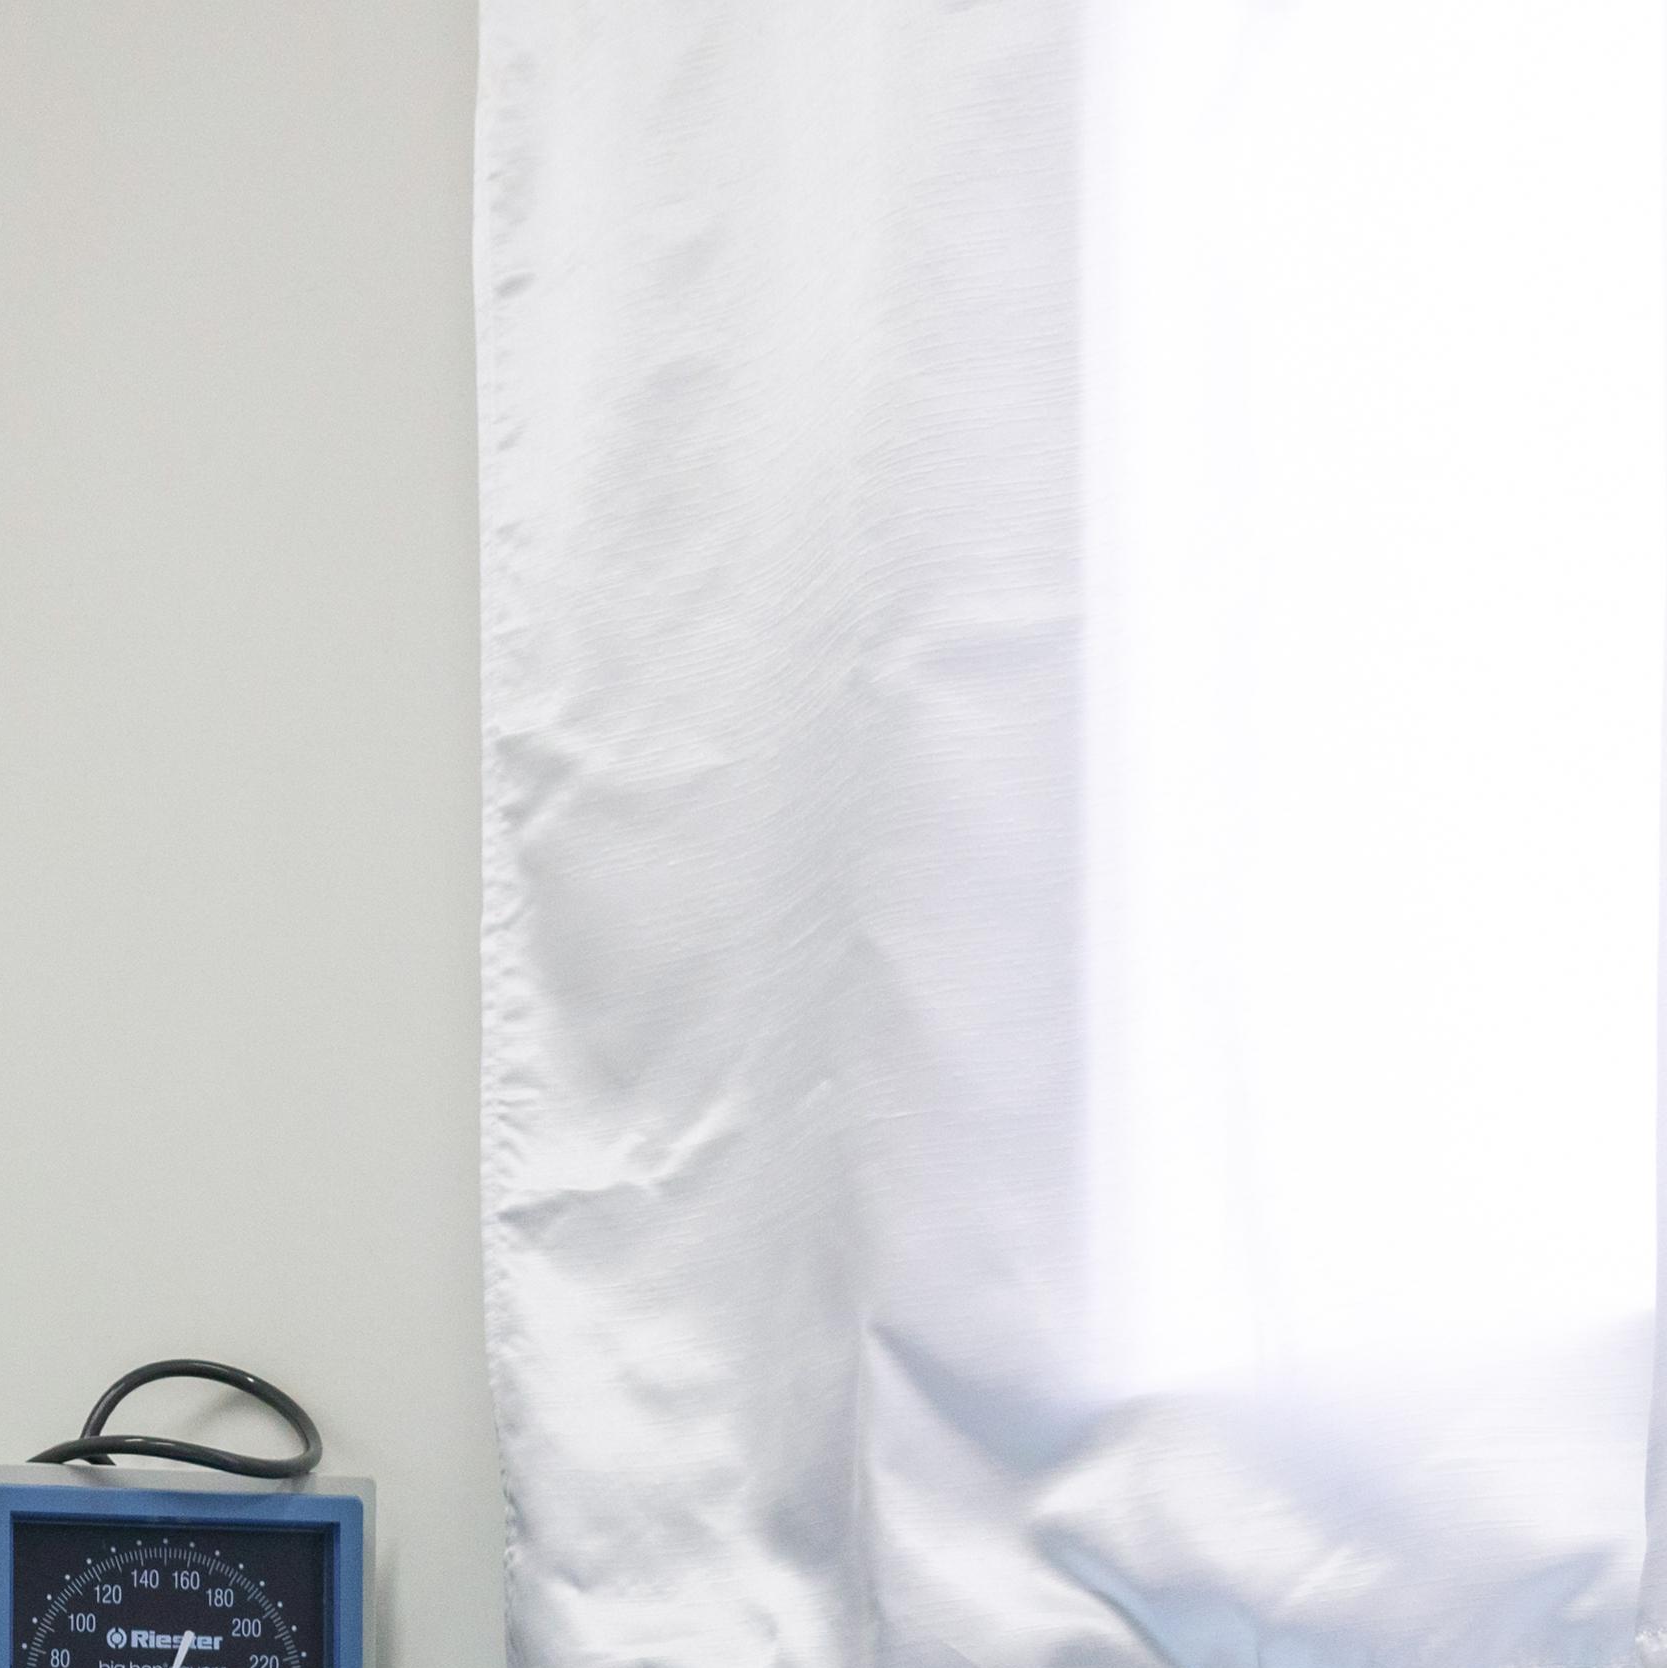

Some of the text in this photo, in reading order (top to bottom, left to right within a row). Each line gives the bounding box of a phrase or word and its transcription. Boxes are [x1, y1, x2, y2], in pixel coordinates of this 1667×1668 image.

[131, 1569, 160, 1589] 140
[172, 1570, 201, 1590] 160
[94, 1585, 123, 1604] 120
[206, 1588, 234, 1608] 180
[68, 1614, 96, 1633] 100
[231, 1618, 262, 1638] 200
[131, 1630, 223, 1650] Rieser
[50, 1649, 71, 1668] 80
